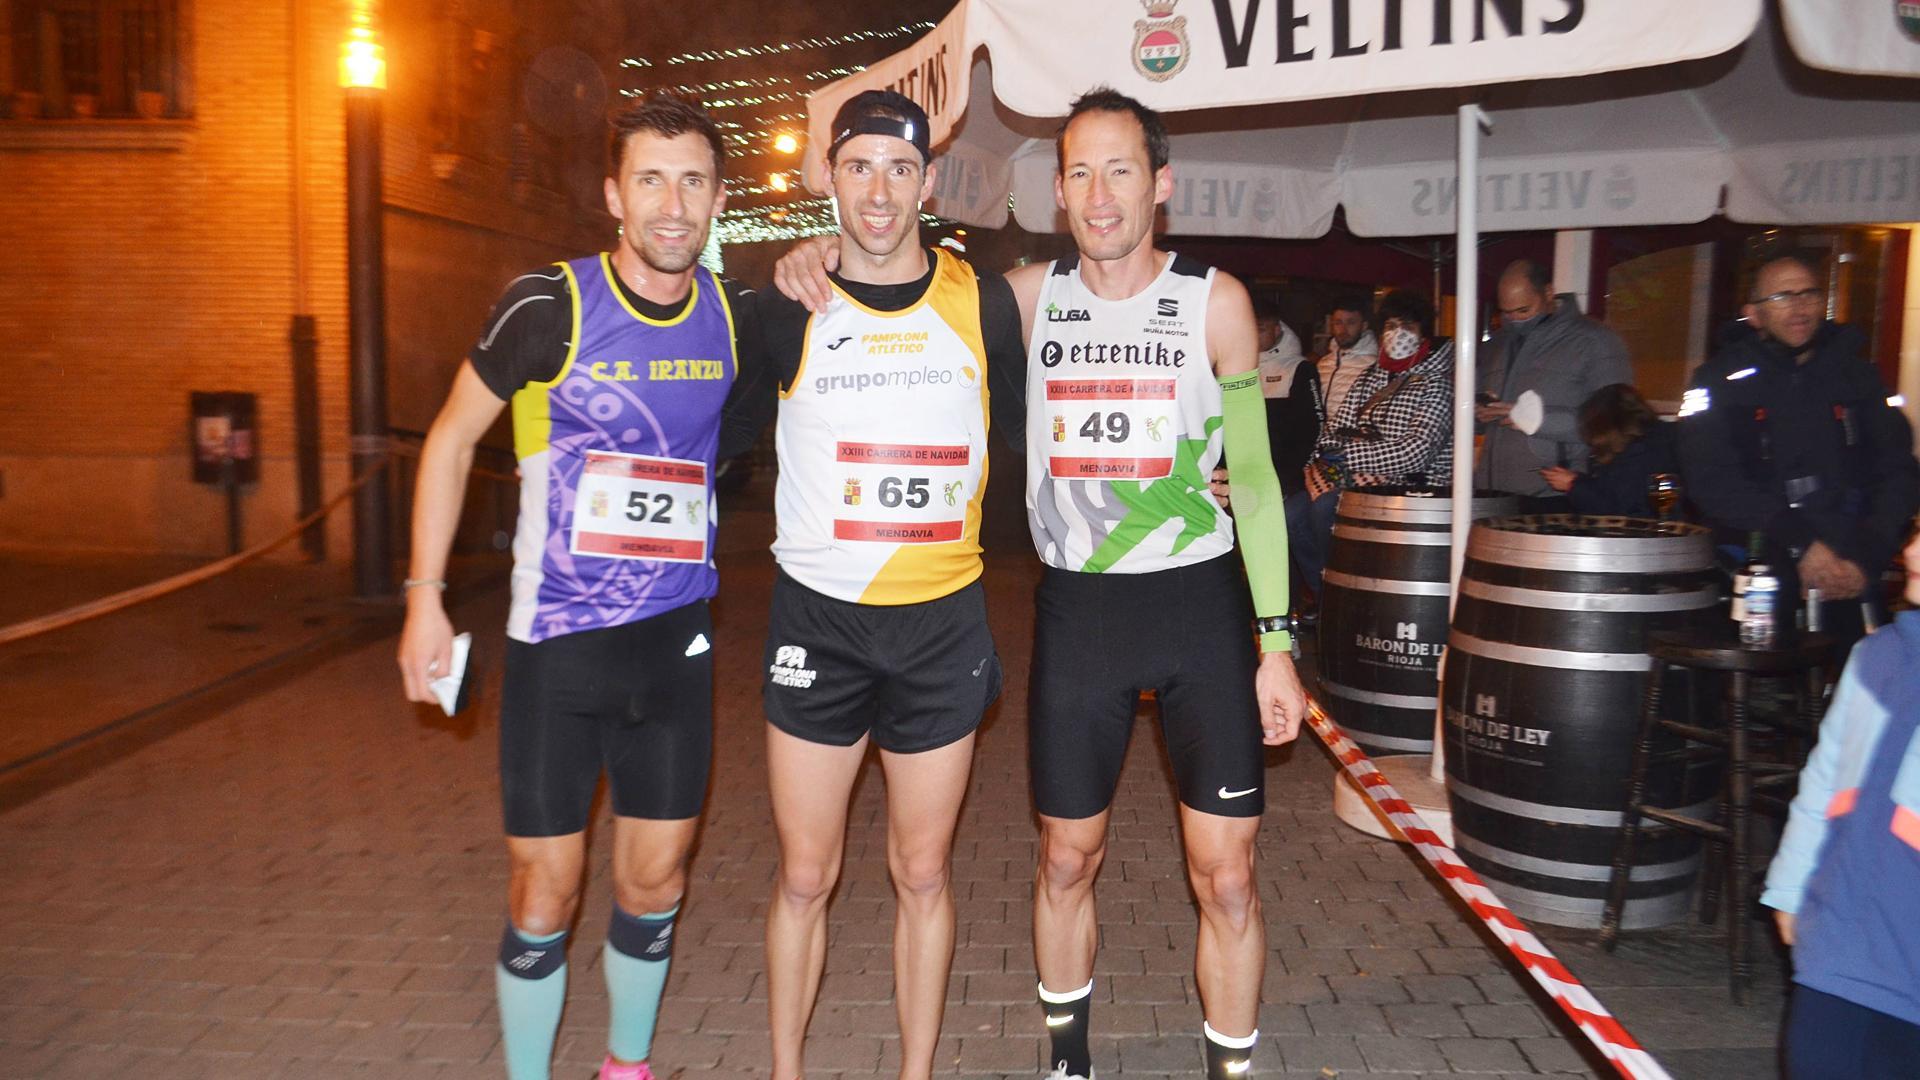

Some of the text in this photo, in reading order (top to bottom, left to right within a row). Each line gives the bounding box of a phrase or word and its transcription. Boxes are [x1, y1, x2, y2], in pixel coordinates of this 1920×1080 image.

[861, 332, 929, 344] PAMPLONA
[1070, 340, 1186, 368] etxenike
[591, 360, 639, 381] C.A.
[815, 366, 952, 395] grupompleo
[1069, 385, 1112, 394] CARRERA
[1115, 385, 1128, 394] DE
[1079, 412, 1131, 444] 49
[841, 447, 968, 460] XXIII CARRERA DE NAVIDAD
[1079, 464, 1137, 474] MENDAVIA
[878, 476, 931, 509] 65
[625, 490, 674, 524] 52
[876, 529, 934, 538] MENDAVIA
[1356, 633, 1405, 654] BARON
[1408, 642, 1430, 656] DE
[1387, 654, 1423, 666] RIOJA
[1487, 720, 1510, 740] DE
[1513, 726, 1551, 747] LEY
